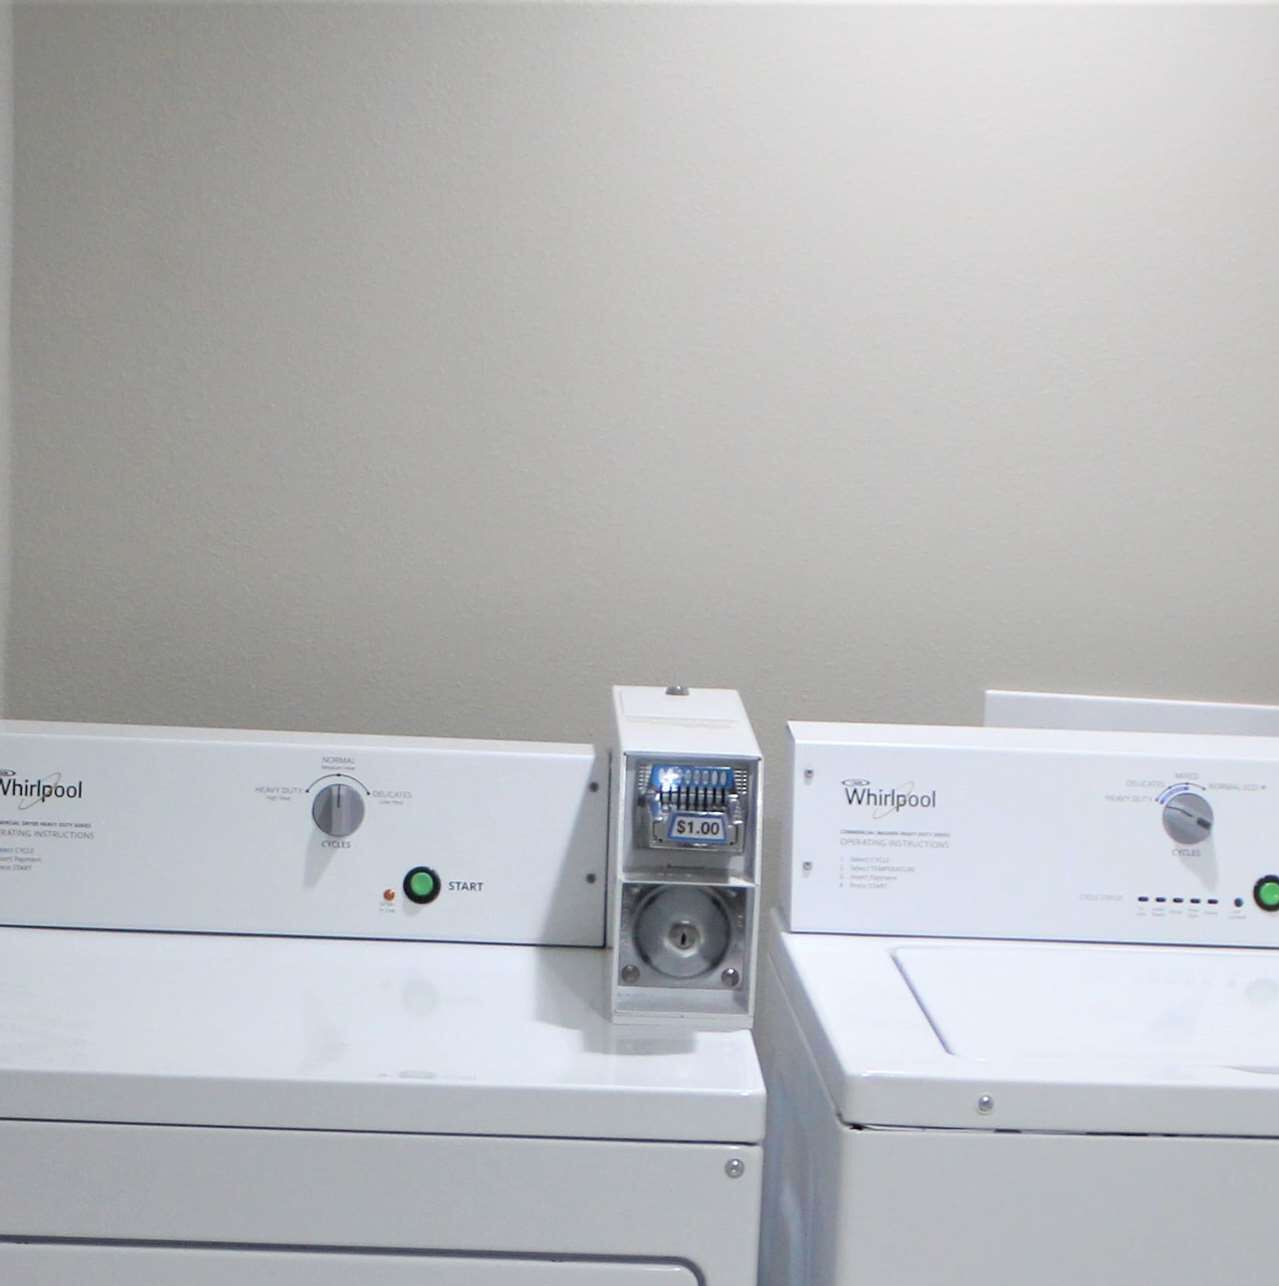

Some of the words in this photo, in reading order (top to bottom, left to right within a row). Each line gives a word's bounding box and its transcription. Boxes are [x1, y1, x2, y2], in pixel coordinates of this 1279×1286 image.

[844, 787, 937, 812] Whirlpool
[677, 820, 720, 835] $1.00
[34, 830, 95, 840] INSTRUCTIONS
[321, 840, 351, 849] CYCLES
[1172, 849, 1201, 857] CYCLES
[448, 881, 484, 891] START
